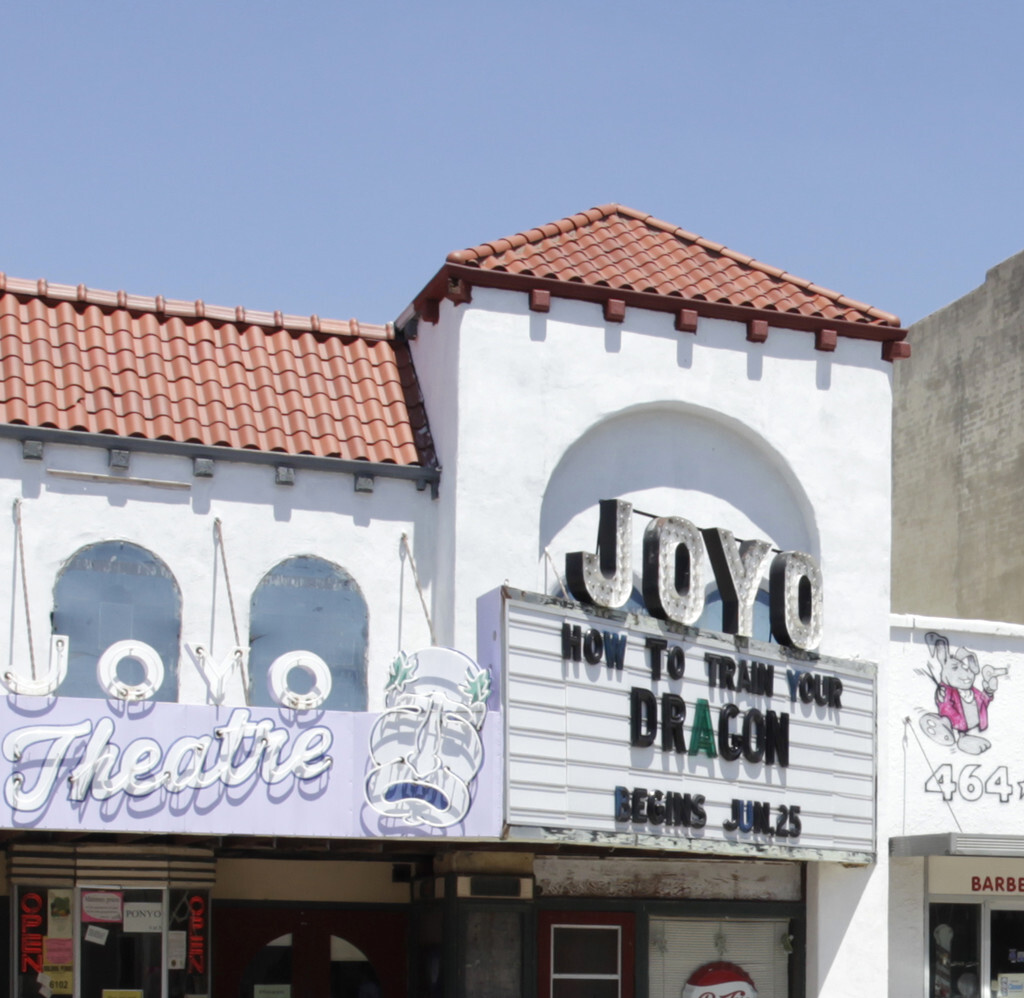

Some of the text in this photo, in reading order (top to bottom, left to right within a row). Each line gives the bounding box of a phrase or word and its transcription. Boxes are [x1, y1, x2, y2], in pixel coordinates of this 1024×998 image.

[565, 498, 824, 651] JOYO
[0, 634, 333, 711] JOYO
[561, 622, 844, 709] HOW TO TRAIN YOUR
[2, 707, 334, 812] Theatre
[630, 686, 790, 768] DRAGON
[614, 785, 708, 830] BEGINS
[20, 892, 44, 974] OPEN
[126, 910, 162, 918] PONYO
[188, 895, 206, 975] OPEN
[49, 980, 68, 989] 6102
